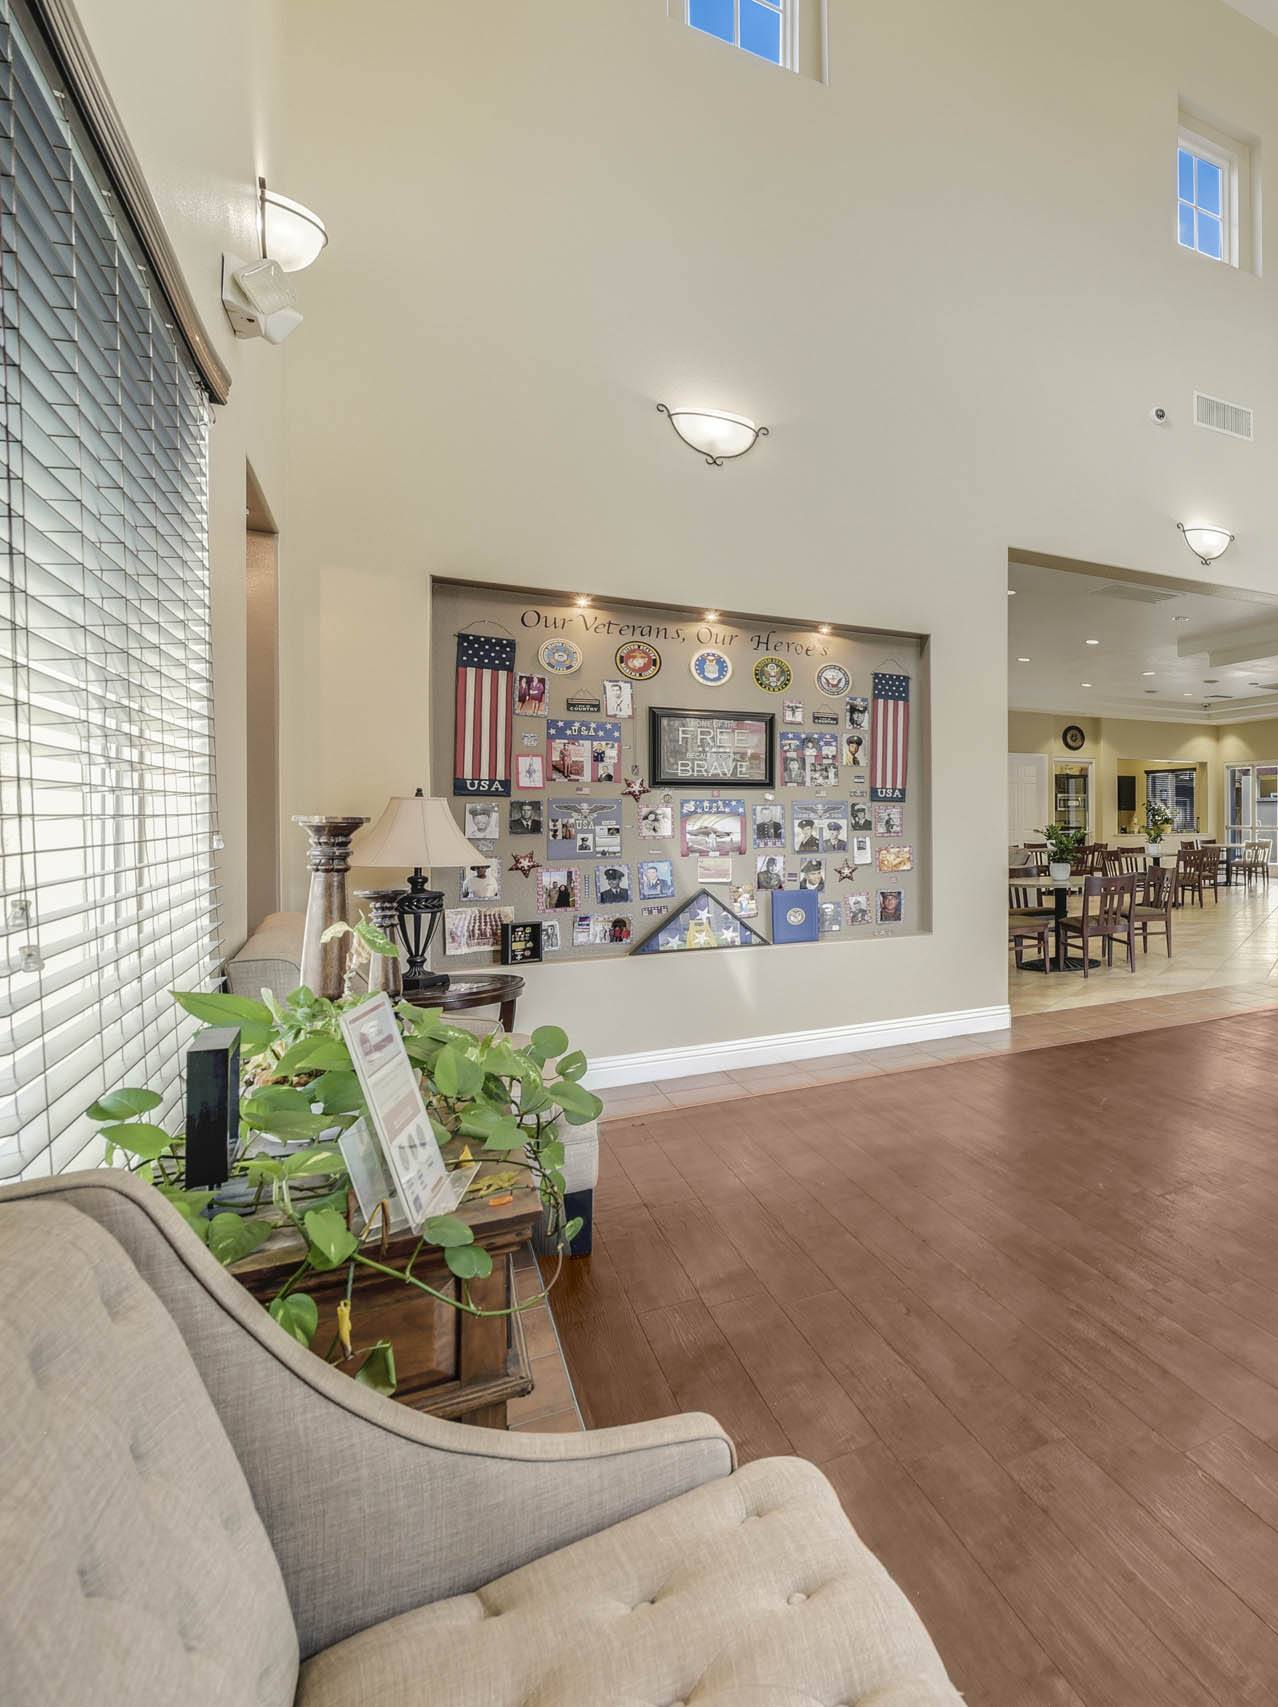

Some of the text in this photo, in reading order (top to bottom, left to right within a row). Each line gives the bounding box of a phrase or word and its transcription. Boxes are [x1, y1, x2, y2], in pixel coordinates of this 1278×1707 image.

[521, 609, 829, 656] Our Veterans, Our Heroes
[571, 726, 596, 736] USA
[678, 727, 750, 747] FREE
[678, 760, 750, 777] BRAVE
[466, 780, 504, 791] USA
[877, 788, 902, 797] USA
[703, 799, 727, 811] USA
[576, 820, 595, 829] USA
